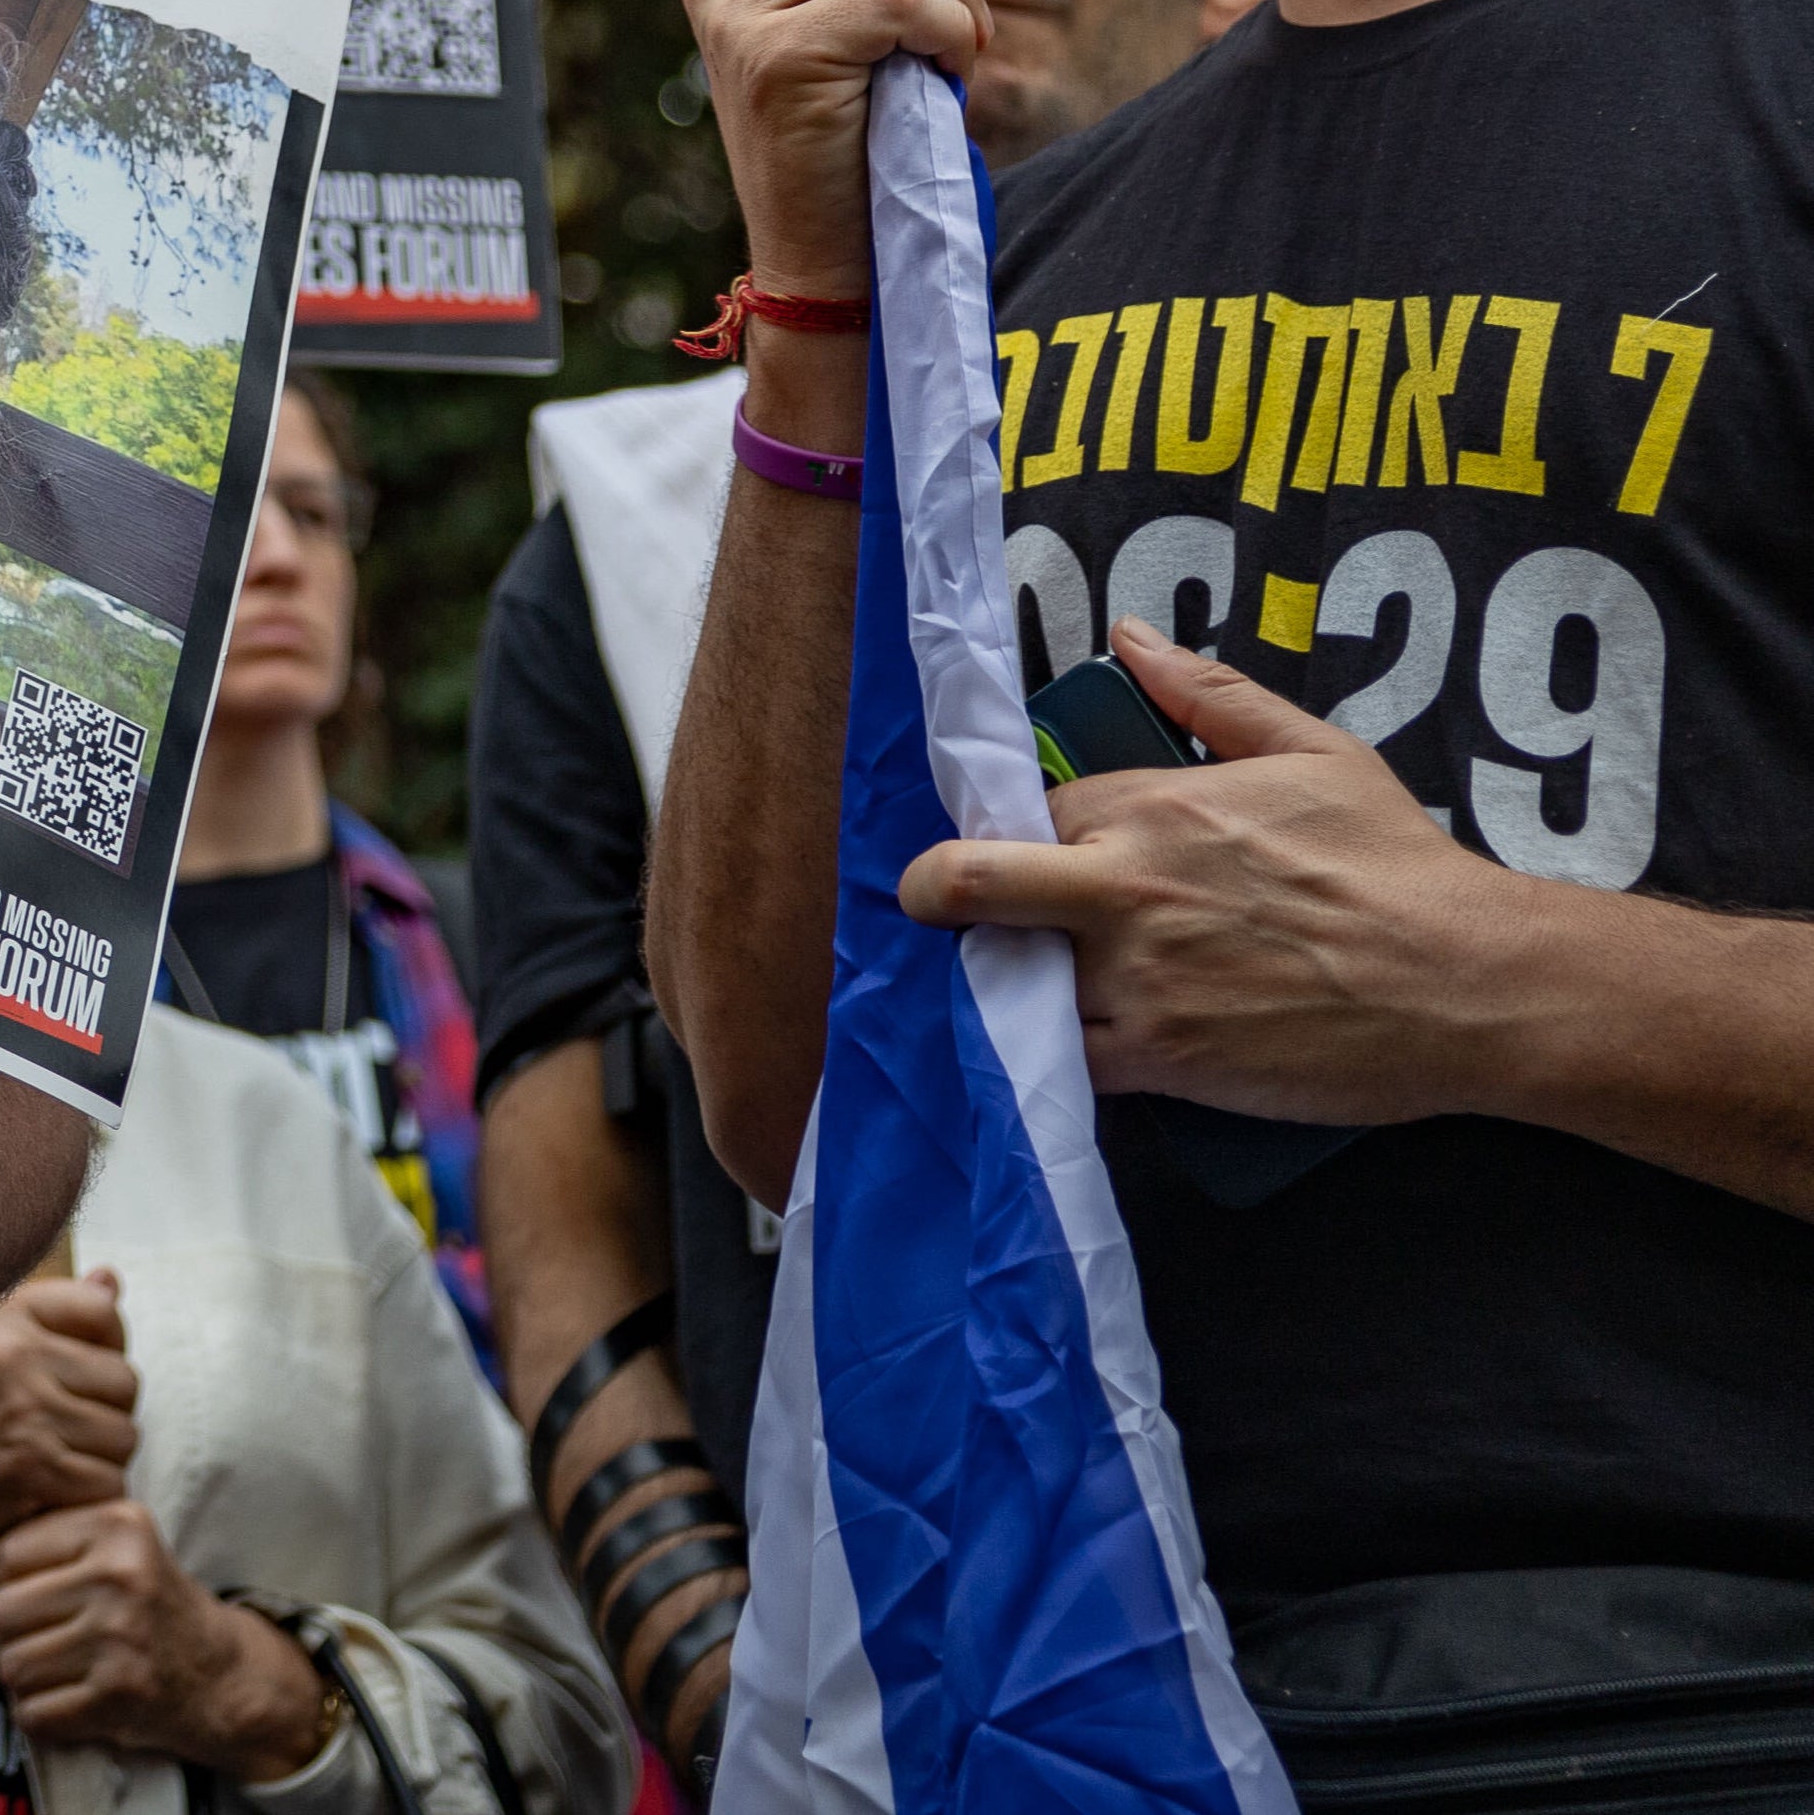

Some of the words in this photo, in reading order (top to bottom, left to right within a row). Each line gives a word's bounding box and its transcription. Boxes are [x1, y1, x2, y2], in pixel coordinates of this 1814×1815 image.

[380, 172, 524, 227] MISSING
[361, 221, 530, 305] FORUM
[996, 292, 1561, 512] באוקטובר
[1611, 314, 1713, 516] 7
[1, 894, 113, 978] MISSING
